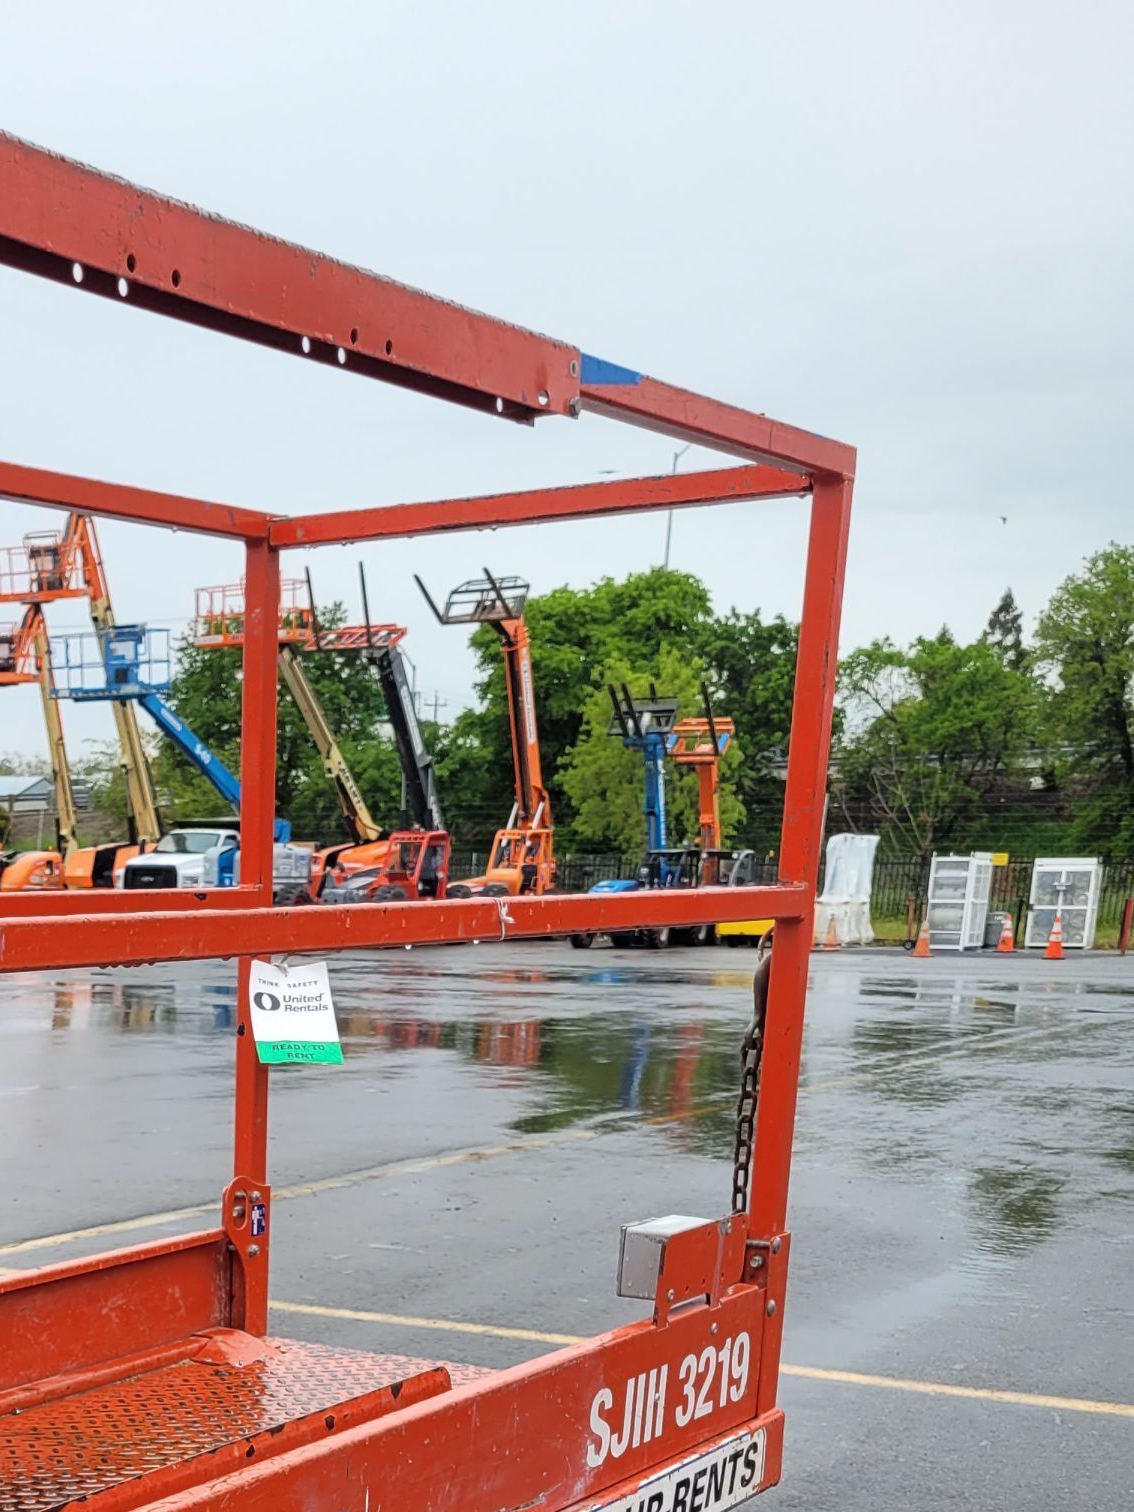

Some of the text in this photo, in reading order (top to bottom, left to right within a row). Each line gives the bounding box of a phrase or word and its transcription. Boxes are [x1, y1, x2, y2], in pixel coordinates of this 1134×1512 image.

[258, 978, 318, 989] THINK SAFETY
[283, 992, 325, 1003] United
[284, 1003, 329, 1013] Rentals
[272, 1044, 307, 1052] READY
[287, 1052, 315, 1060] RENT
[675, 1332, 750, 1427] 3219
